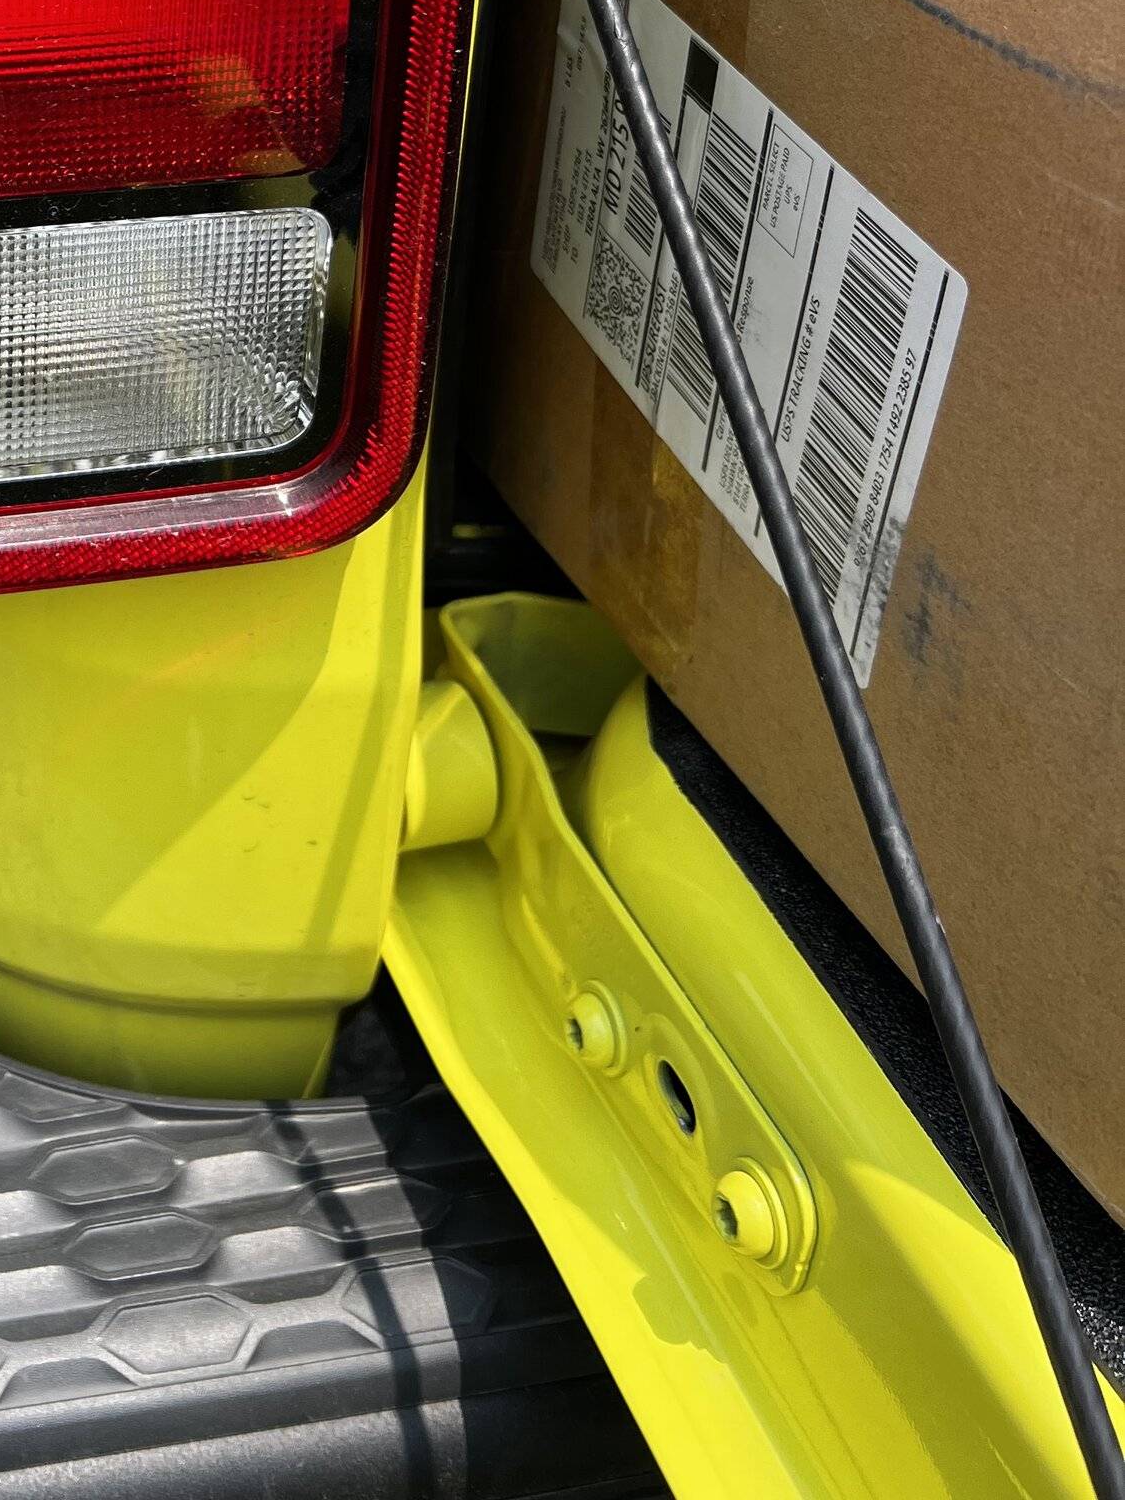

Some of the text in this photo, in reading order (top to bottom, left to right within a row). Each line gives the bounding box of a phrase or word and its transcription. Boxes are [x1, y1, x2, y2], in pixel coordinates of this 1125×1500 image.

[595, 136, 605, 160] WV
[607, 115, 629, 170] 215
[590, 164, 601, 199] ALTA
[601, 165, 623, 216] MD
[761, 140, 780, 211] PARCEL SELECT
[769, 145, 790, 229] US POSTAGE PAID
[783, 183, 793, 205] UPS
[566, 183, 577, 217] USPS
[570, 244, 579, 265] TO
[584, 149, 592, 165] ST
[584, 196, 596, 238] TERRA
[791, 192, 800, 212] eVS
[662, 315, 671, 333] 1Z
[664, 293, 675, 319] 256
[735, 272, 756, 336] Response
[639, 277, 667, 395] UPS SUREPOST
[649, 343, 665, 405] TRACKING
[780, 404, 795, 443] USPS
[788, 334, 811, 408] TRACKING
[806, 293, 820, 326] eVS
[902, 345, 917, 370] 97
[893, 365, 912, 406] 2385
[885, 400, 903, 439] 1492
[876, 434, 894, 474] 1754
[867, 468, 886, 509] 8403
[860, 501, 877, 541] 2909
